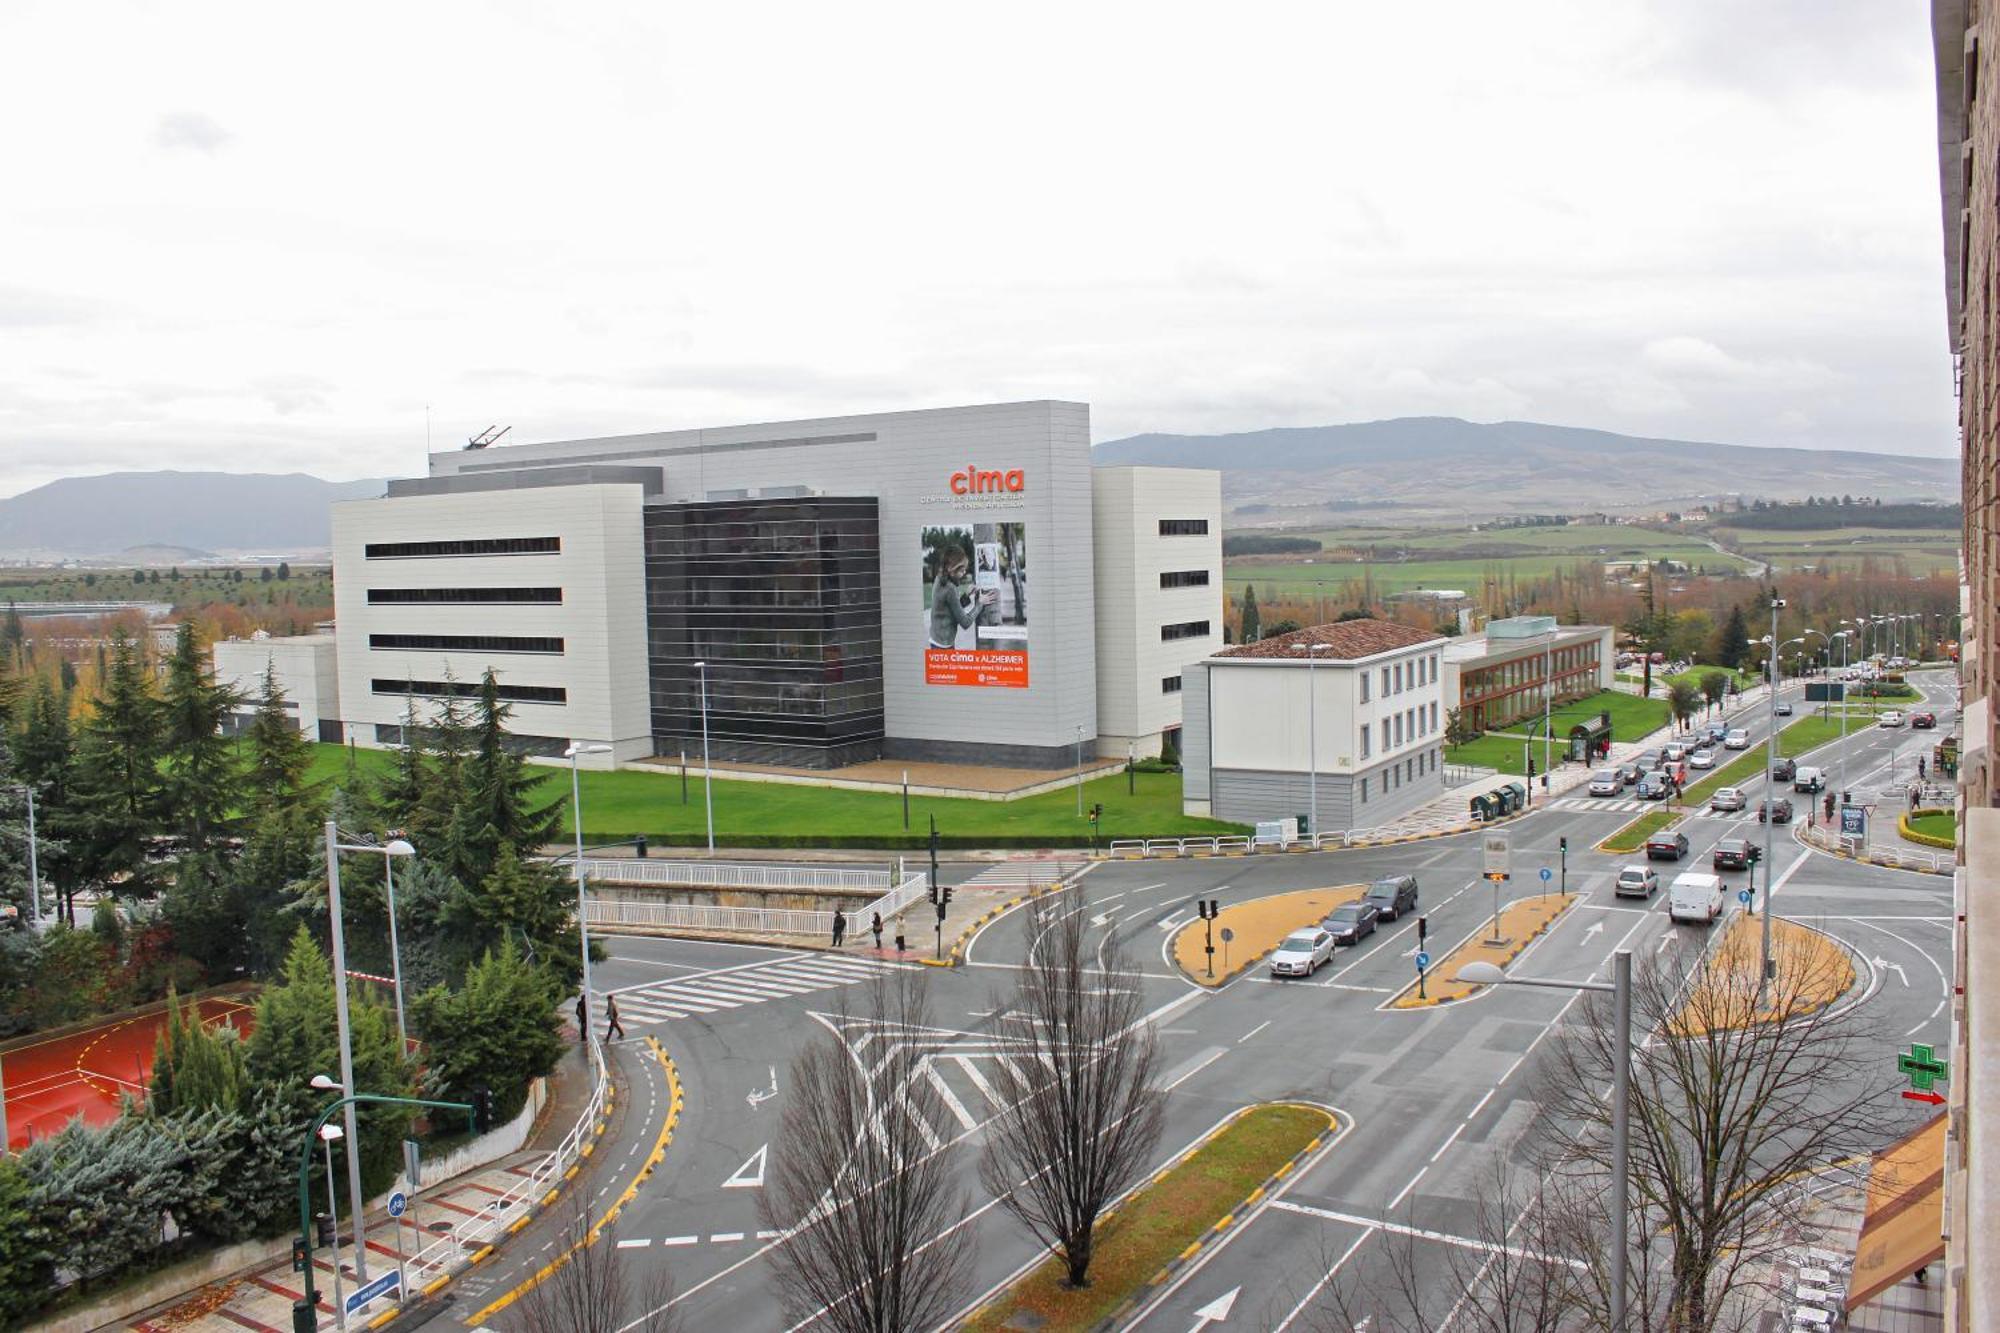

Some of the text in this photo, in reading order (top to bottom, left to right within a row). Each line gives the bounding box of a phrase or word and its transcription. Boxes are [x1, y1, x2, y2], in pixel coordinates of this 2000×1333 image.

[950, 464, 1024, 494] cima
[929, 653, 949, 662] VOTA
[950, 652, 974, 662] cima
[981, 655, 1024, 664] ALZHEIMER
